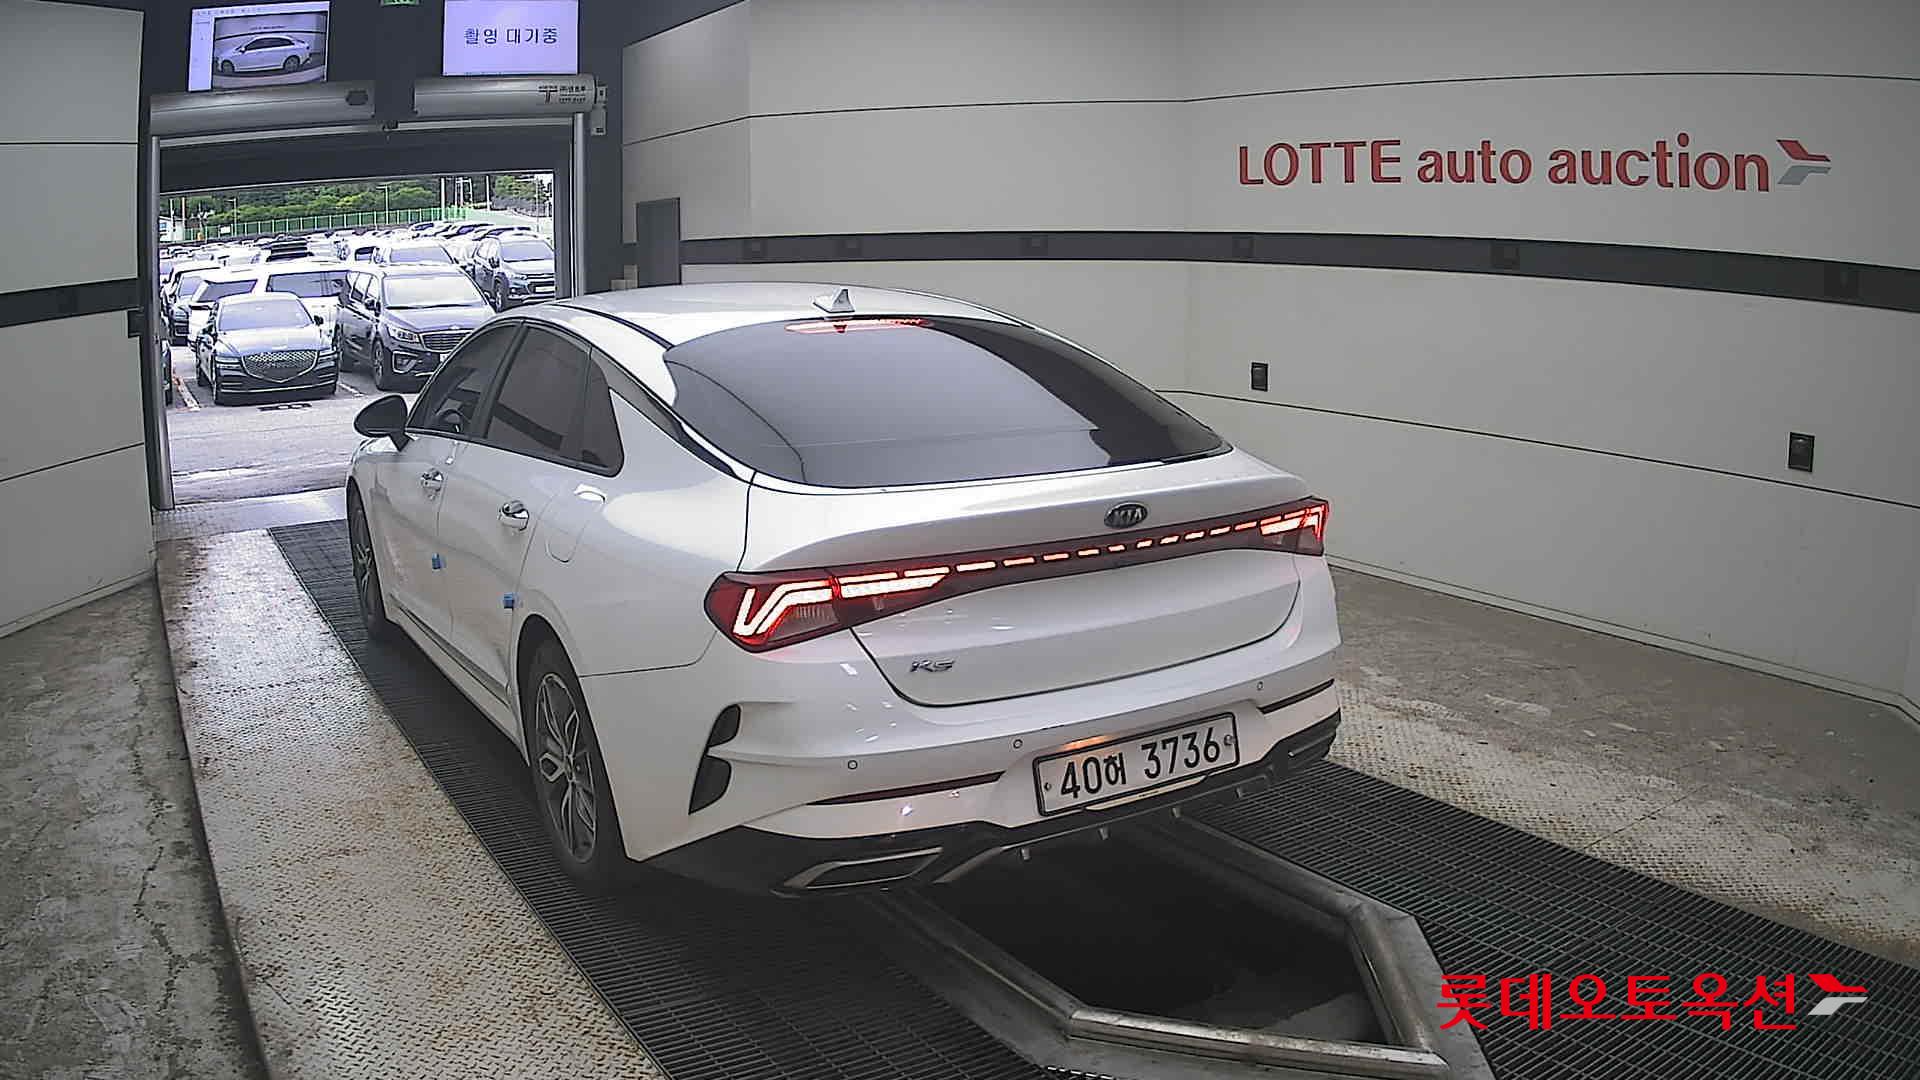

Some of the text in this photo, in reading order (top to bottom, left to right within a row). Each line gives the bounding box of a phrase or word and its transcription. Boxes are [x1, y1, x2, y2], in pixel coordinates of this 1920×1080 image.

[506, 28, 558, 45] 대기중
[1239, 133, 1770, 192] LOTTE auto auction
[1060, 727, 1221, 799] 40허 3736
